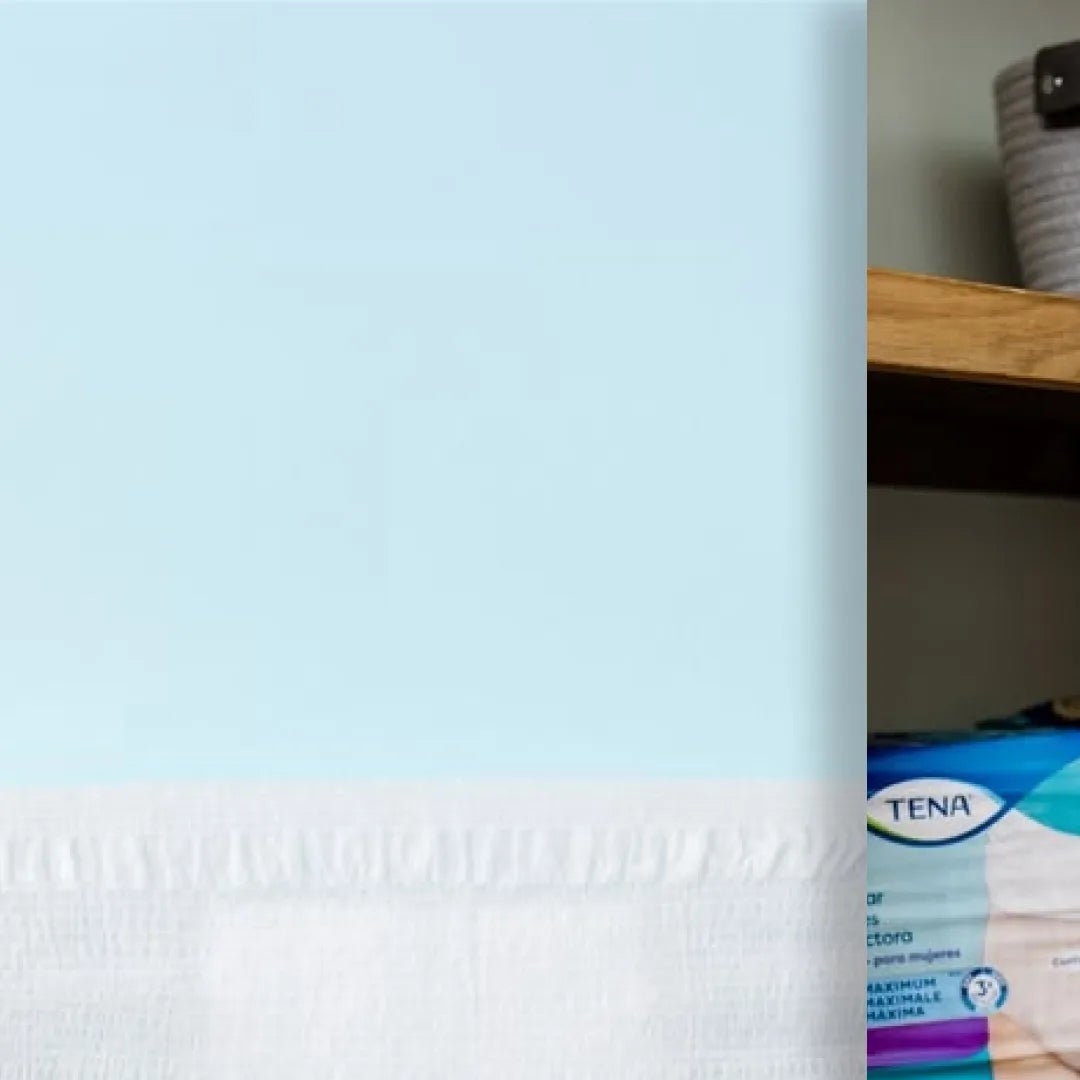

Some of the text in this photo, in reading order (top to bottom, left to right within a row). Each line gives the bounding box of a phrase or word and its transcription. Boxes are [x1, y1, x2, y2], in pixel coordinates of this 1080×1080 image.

[884, 794, 972, 821] TENA
[867, 931, 913, 947] ctora
[874, 948, 961, 968] para mujeres
